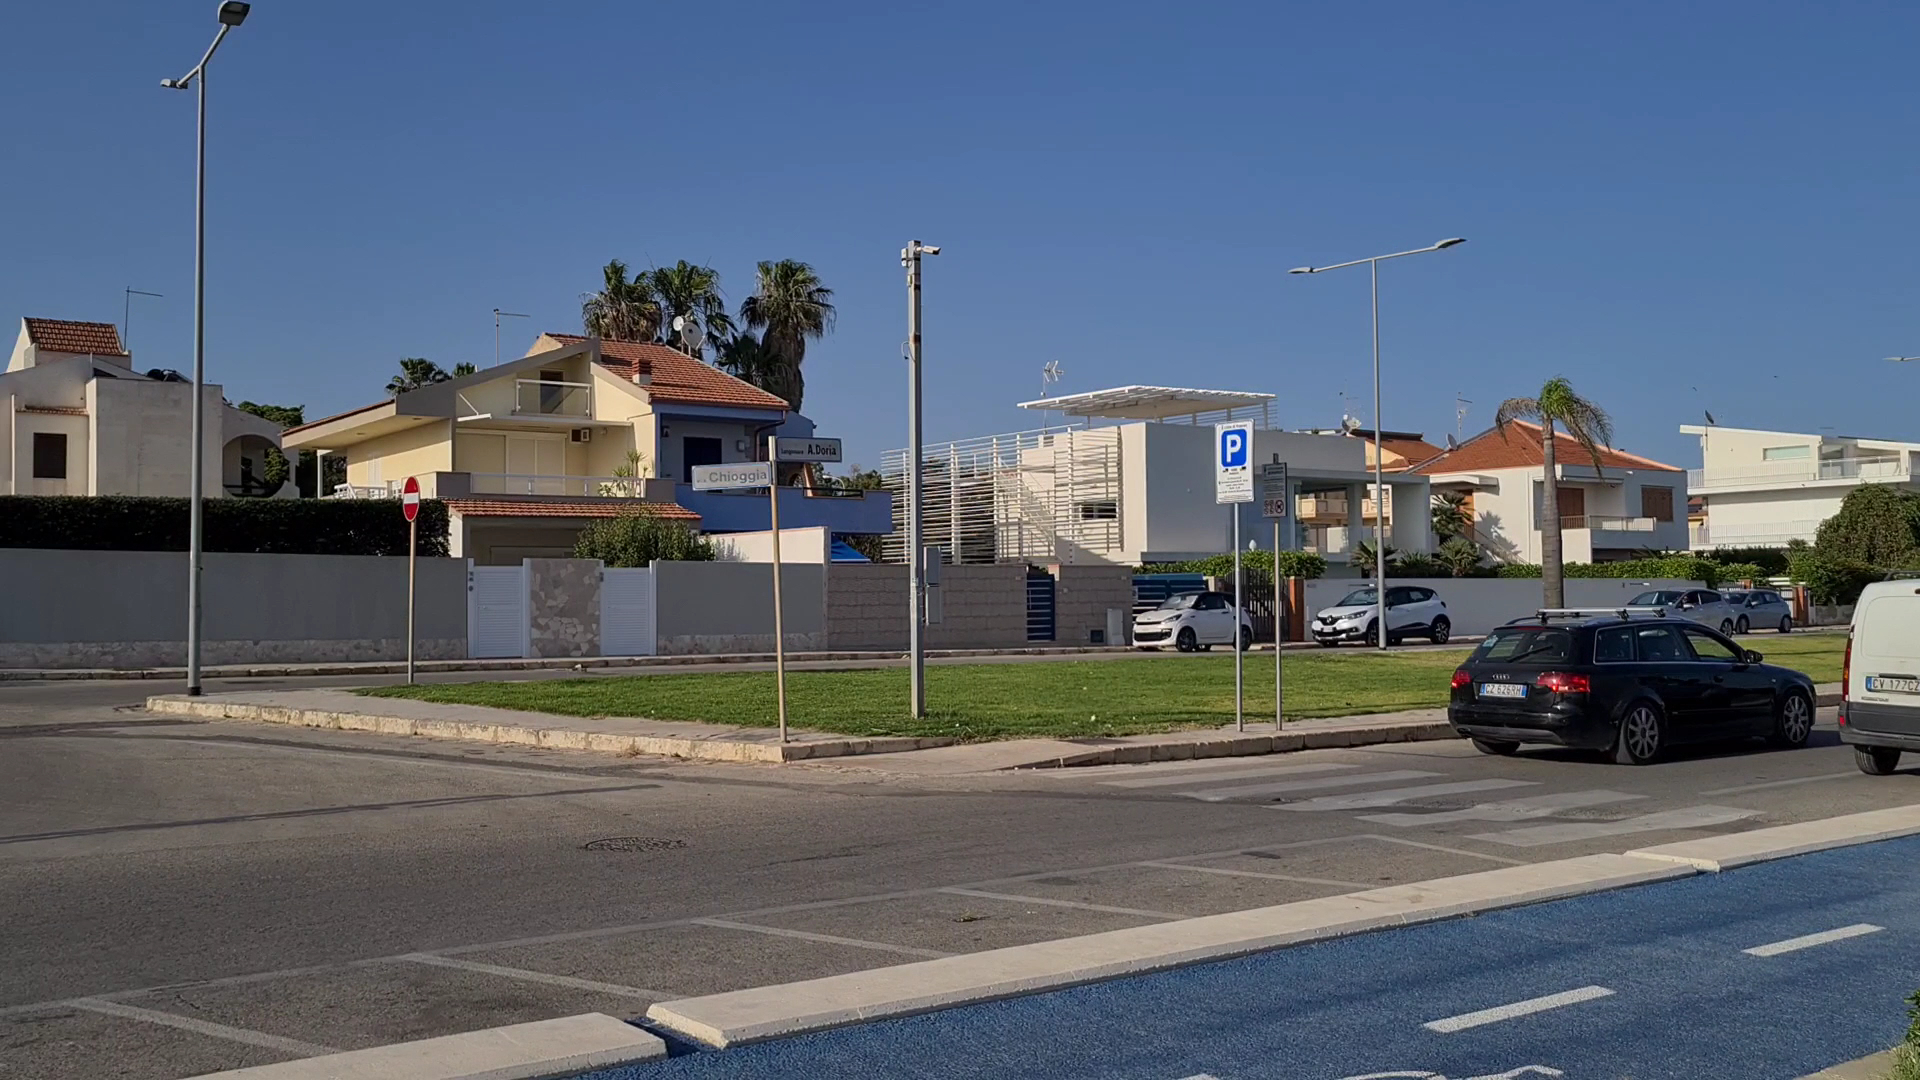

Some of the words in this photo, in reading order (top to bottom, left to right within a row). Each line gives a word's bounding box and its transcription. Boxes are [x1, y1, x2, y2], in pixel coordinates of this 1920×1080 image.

[808, 444, 836, 455] A.Doria
[1227, 434, 1241, 463] P
[709, 469, 767, 484] Chioggia
[1486, 684, 1495, 693] CZ
[1873, 679, 1884, 688] CV
[1890, 680, 1919, 691] 177CZ
